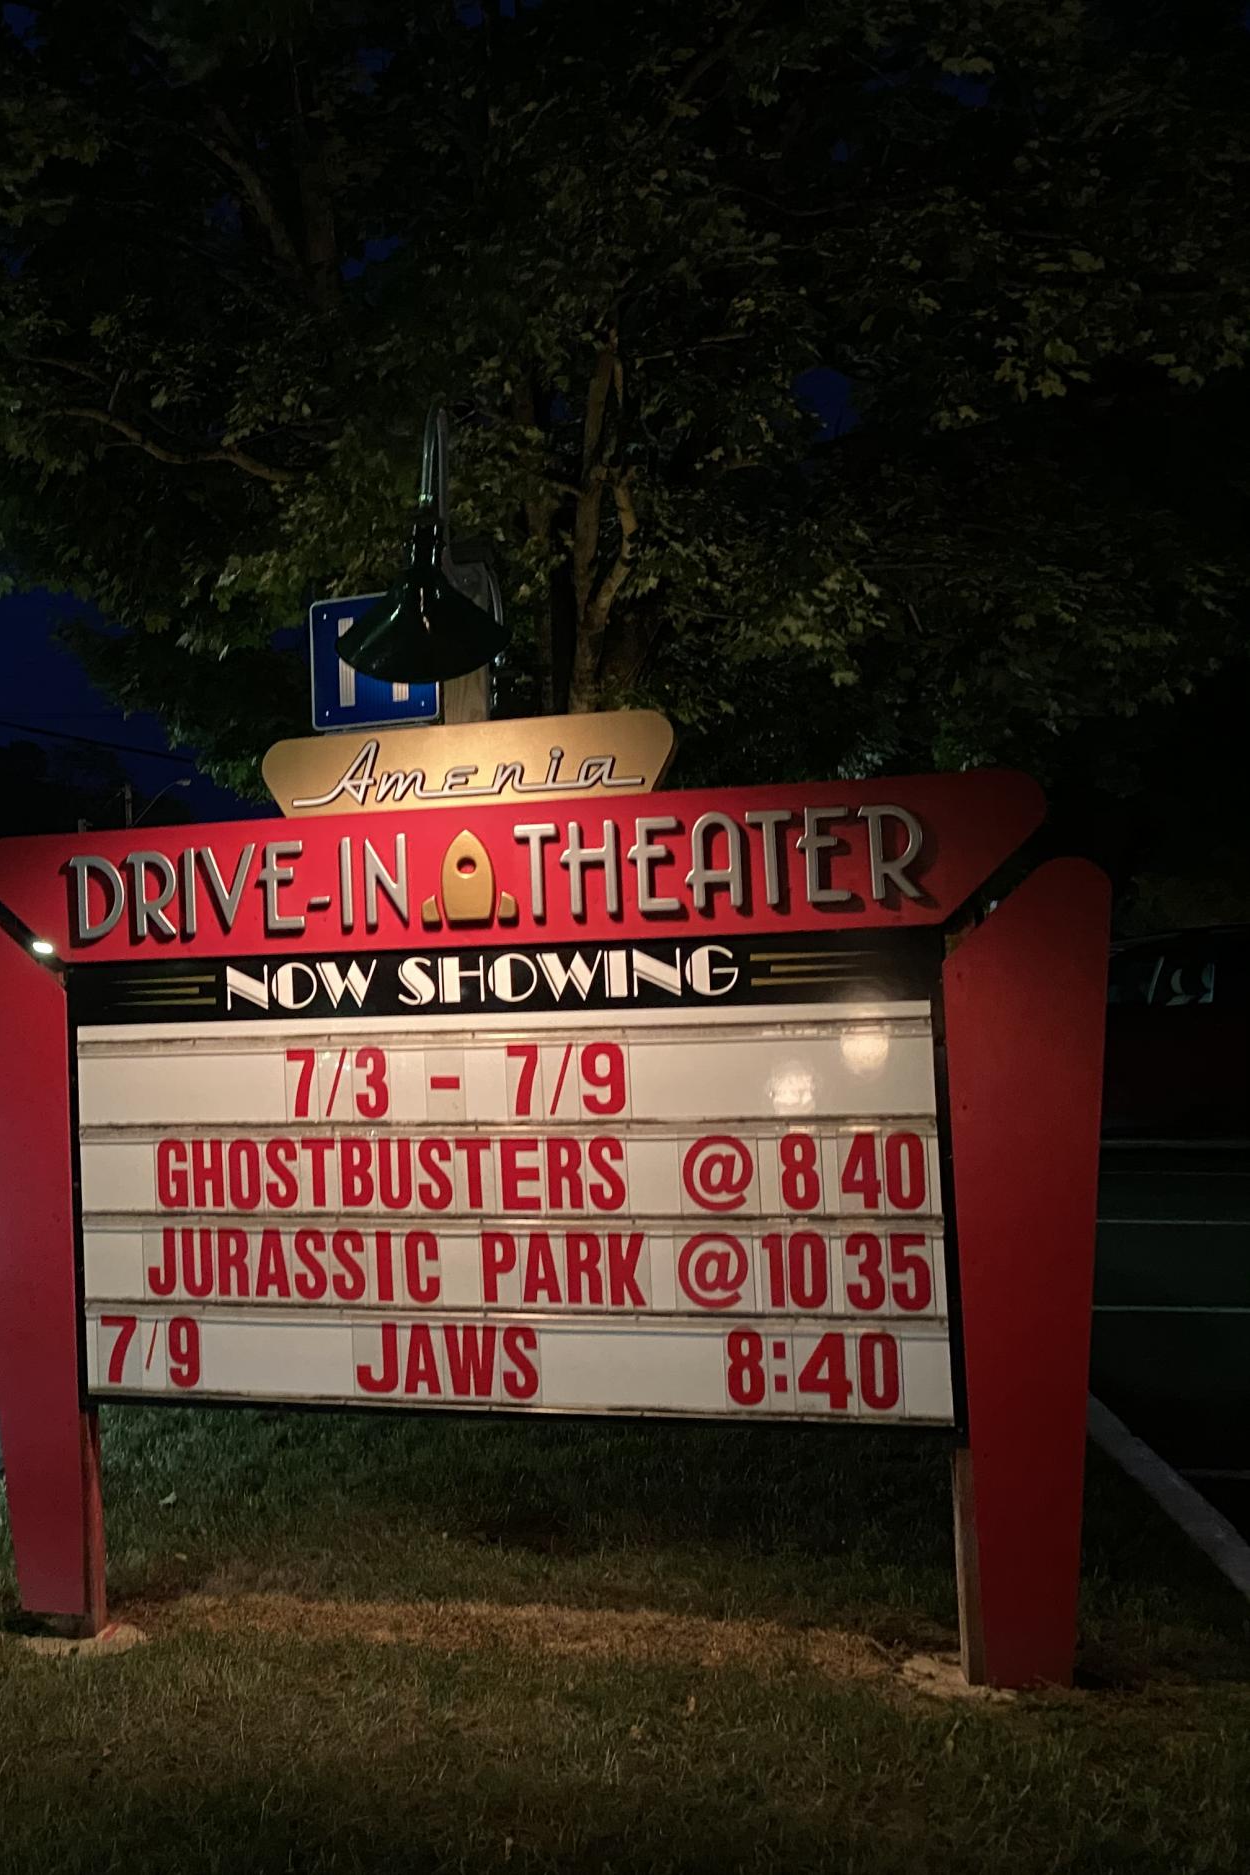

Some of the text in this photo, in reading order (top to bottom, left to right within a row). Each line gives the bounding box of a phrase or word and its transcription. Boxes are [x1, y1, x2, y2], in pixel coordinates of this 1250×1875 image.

[292, 738, 643, 807] Amenia
[68, 804, 927, 939] DRIVE-IN THEATER
[226, 944, 740, 1011] NOW SHOWING
[285, 1044, 390, 1120] 7/3
[504, 1040, 627, 1118] 7/9
[156, 1135, 627, 1213] GHOSTBUSTERS
[147, 1228, 442, 1305] JURASSIC
[480, 1229, 648, 1306] PARK
[100, 1315, 899, 1410] 7/9 JAWS 8:40
